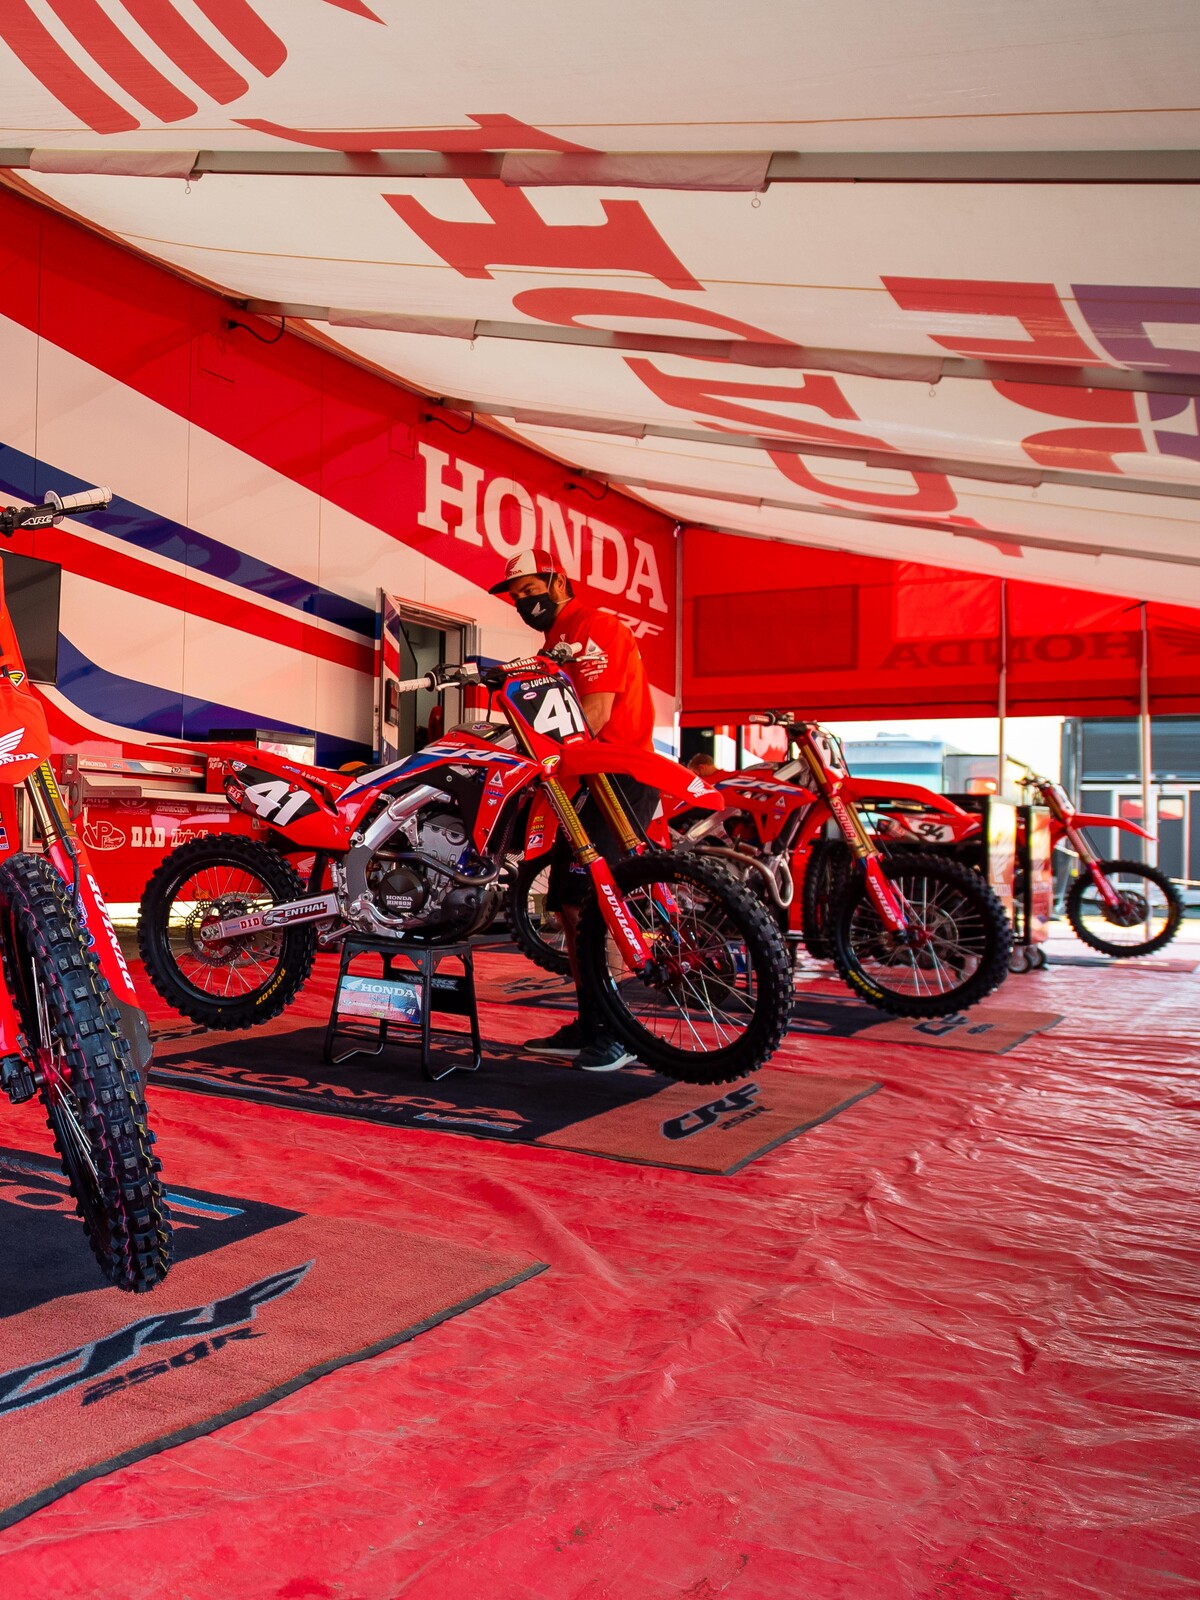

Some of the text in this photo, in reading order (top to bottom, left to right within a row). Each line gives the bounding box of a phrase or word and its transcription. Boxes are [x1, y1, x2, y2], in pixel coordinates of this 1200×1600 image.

[21, 515, 53, 527] ARC
[417, 440, 669, 614] HONDA
[502, 657, 538, 671] RENTHAL
[533, 685, 585, 738] 41
[85, 759, 108, 768] HONDA
[417, 746, 519, 761] CRF
[244, 780, 312, 827] 41
[261, 901, 328, 927] RENTHAL
[600, 883, 641, 953] DUNLOP
[868, 875, 899, 924] DUNLOP
[87, 874, 136, 993] DUNLOP
[256, 966, 287, 1006] DUNLOP
[361, 983, 416, 998] HONDA
[165, 1058, 533, 1123] HONDA
[660, 1082, 763, 1141] CRF
[81, 1326, 266, 1407] 250R
